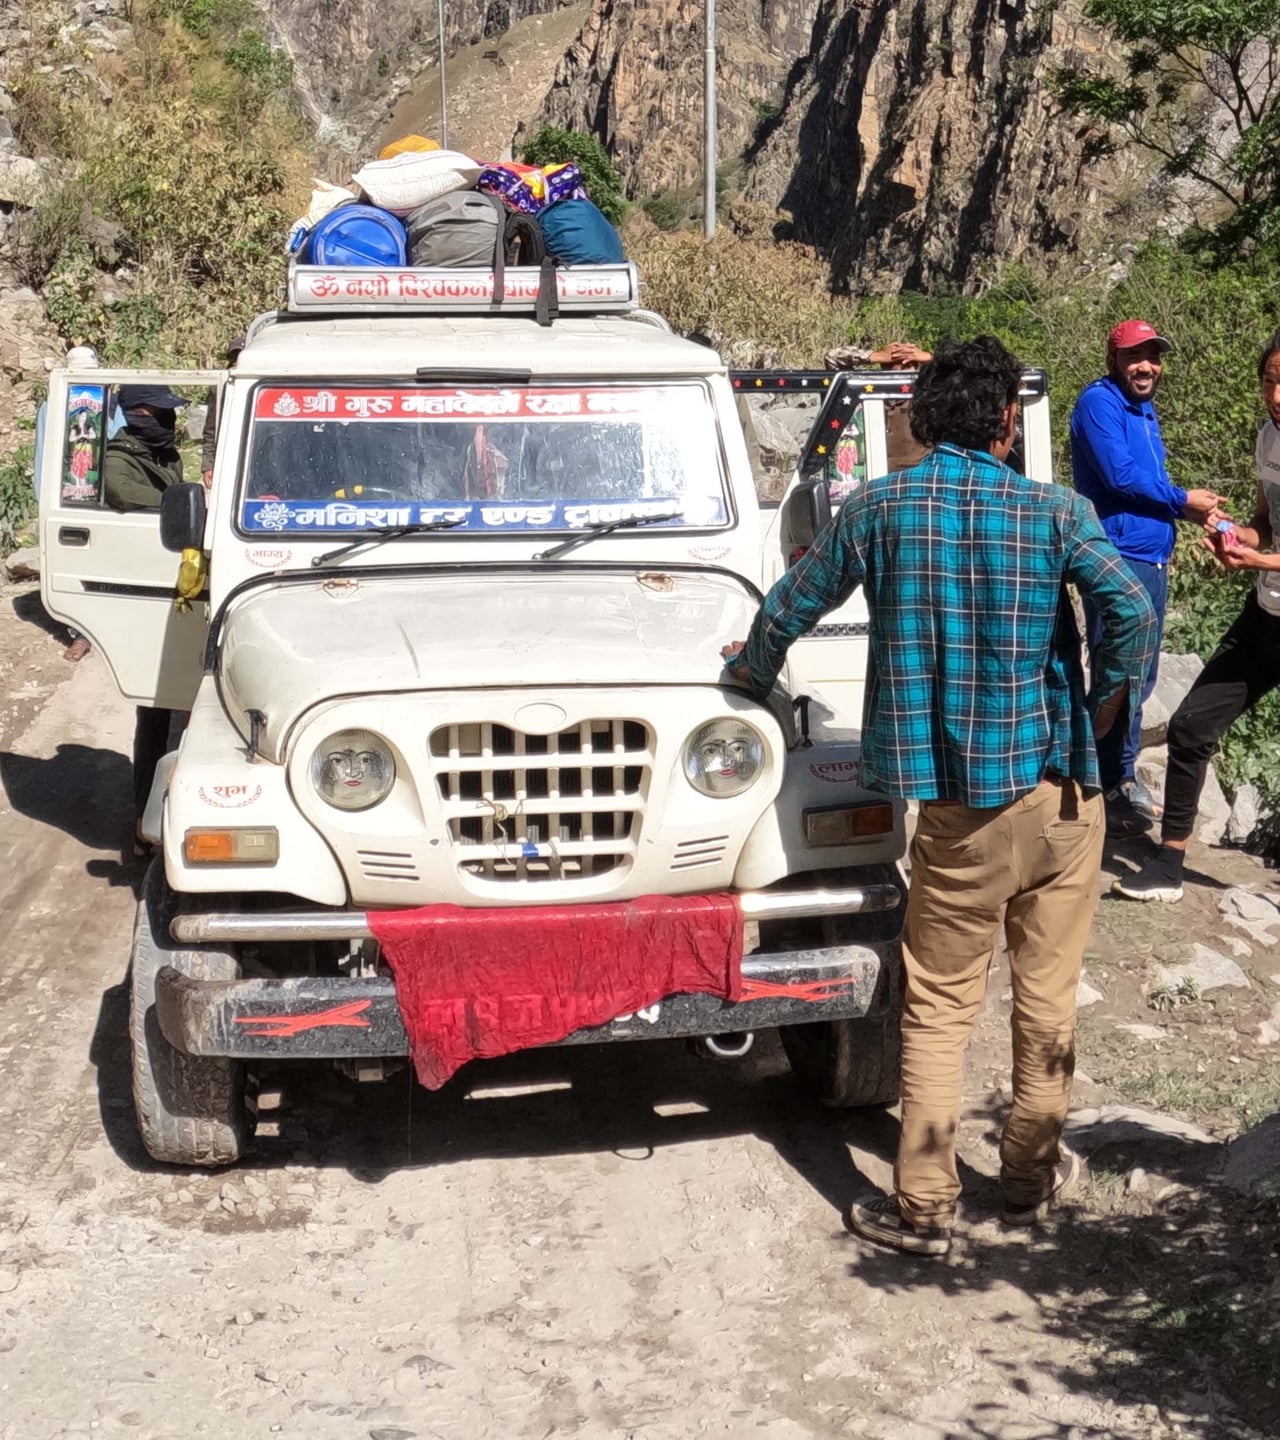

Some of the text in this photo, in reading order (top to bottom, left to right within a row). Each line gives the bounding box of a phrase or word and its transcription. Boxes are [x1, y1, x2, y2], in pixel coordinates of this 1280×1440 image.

[345, 273, 390, 296] नमो
[302, 391, 338, 412] श्री
[294, 502, 411, 526] मनिशा
[479, 504, 556, 525] एण्ड
[212, 785, 248, 799] शुभ
